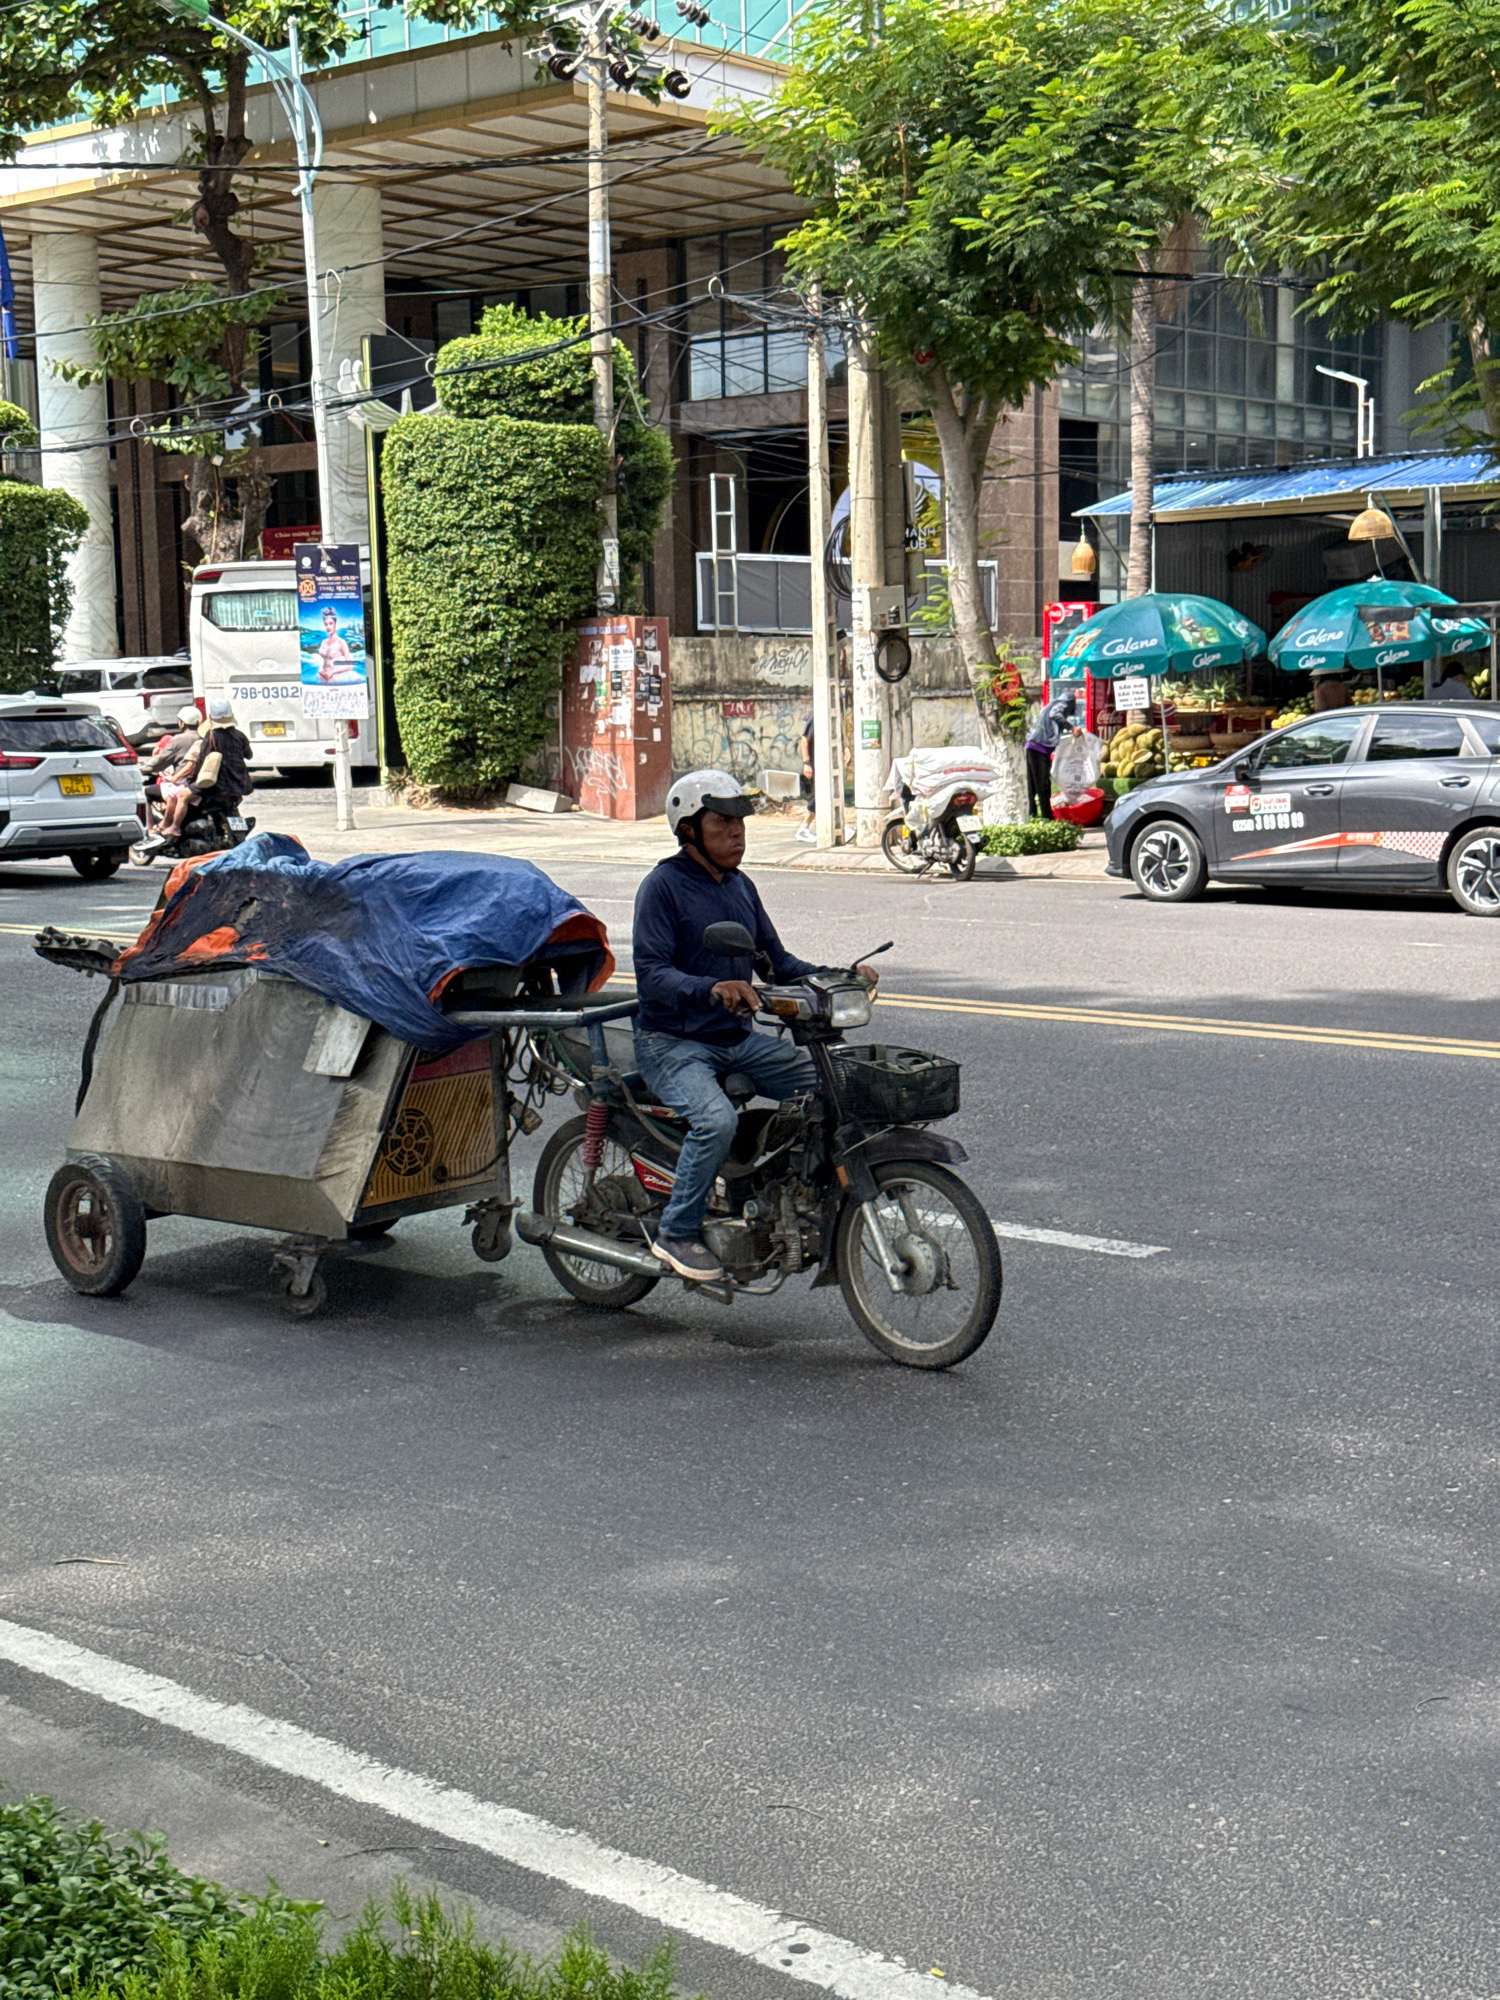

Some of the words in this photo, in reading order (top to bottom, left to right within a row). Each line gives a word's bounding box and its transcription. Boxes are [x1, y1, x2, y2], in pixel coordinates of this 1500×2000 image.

[1102, 636, 1159, 657] Celano
[1295, 628, 1345, 648] Celano
[1192, 651, 1222, 669] Celano
[1298, 654, 1327, 669] Celano
[1375, 649, 1410, 667] Celano
[1111, 661, 1146, 677] Celano
